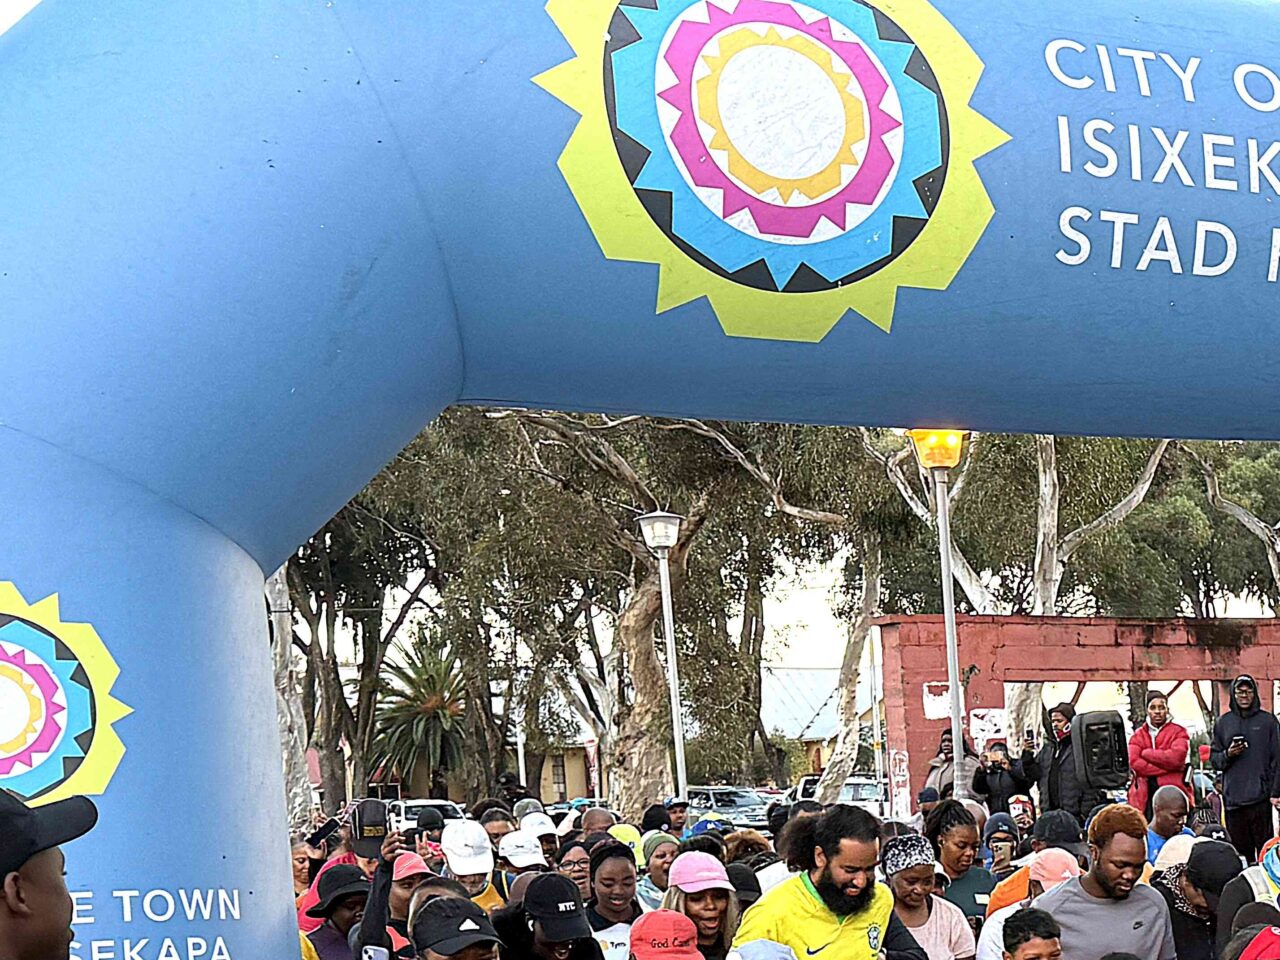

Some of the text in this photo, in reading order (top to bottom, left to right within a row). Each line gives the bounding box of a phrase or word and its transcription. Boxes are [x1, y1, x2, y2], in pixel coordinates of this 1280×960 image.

[1044, 38, 1201, 103] CITY
[1054, 206, 1237, 278] STAD
[112, 888, 241, 923] TOWN
[558, 902, 576, 912] NYC
[651, 938, 669, 949] God
